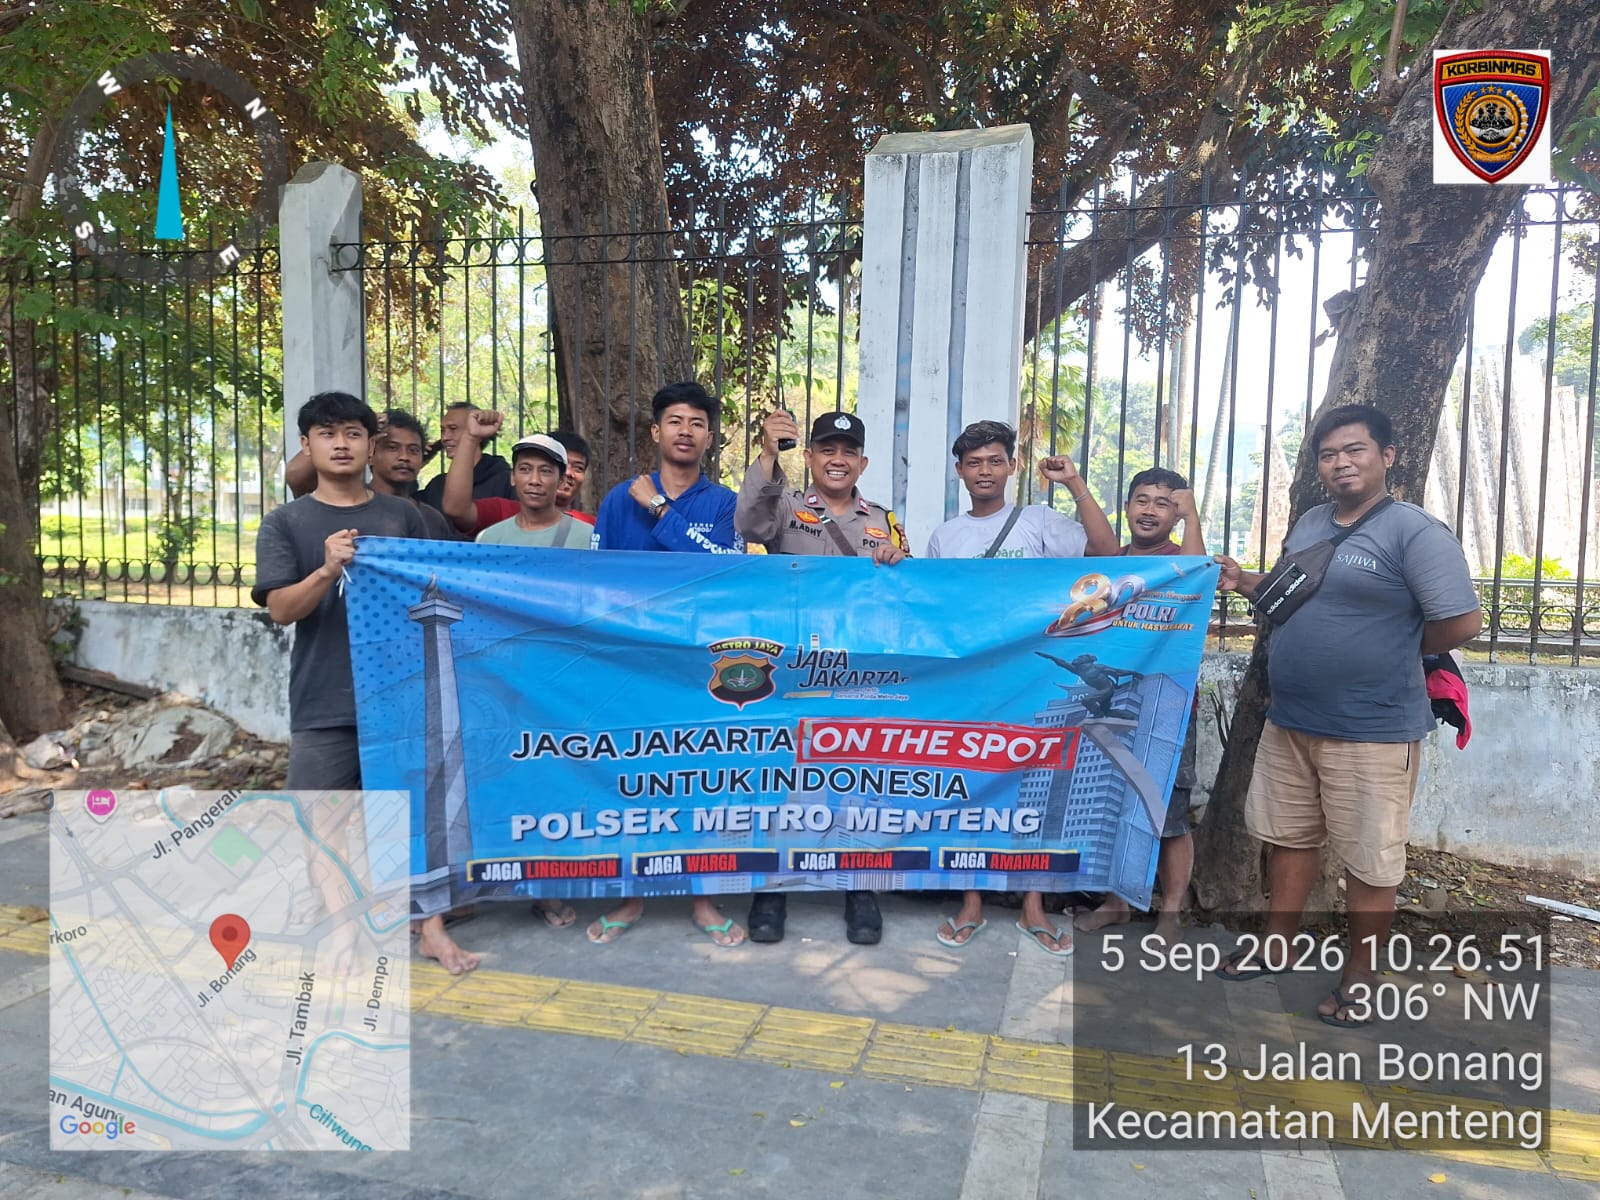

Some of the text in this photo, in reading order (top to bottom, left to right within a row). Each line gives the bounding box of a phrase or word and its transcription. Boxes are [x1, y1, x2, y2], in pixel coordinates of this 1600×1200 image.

[1335, 553, 1377, 570] SAJIWA
[1285, 573, 1307, 596] adidas
[1122, 603, 1178, 622] POLRI
[754, 641, 780, 655] JAYA
[787, 645, 848, 670] JAGA
[511, 726, 1061, 763] JAGA JAKARTA ON THE SPOT
[618, 766, 970, 801] UNTUK INDONESIA
[510, 804, 1042, 841] POLSEK METRO MENTENG
[481, 859, 617, 881] JAGA LINGKUNGAN
[643, 853, 737, 876] JAGA WARGA
[799, 851, 893, 870] JAGA ATURAN
[950, 852, 1050, 870] JAGA AMANAH
